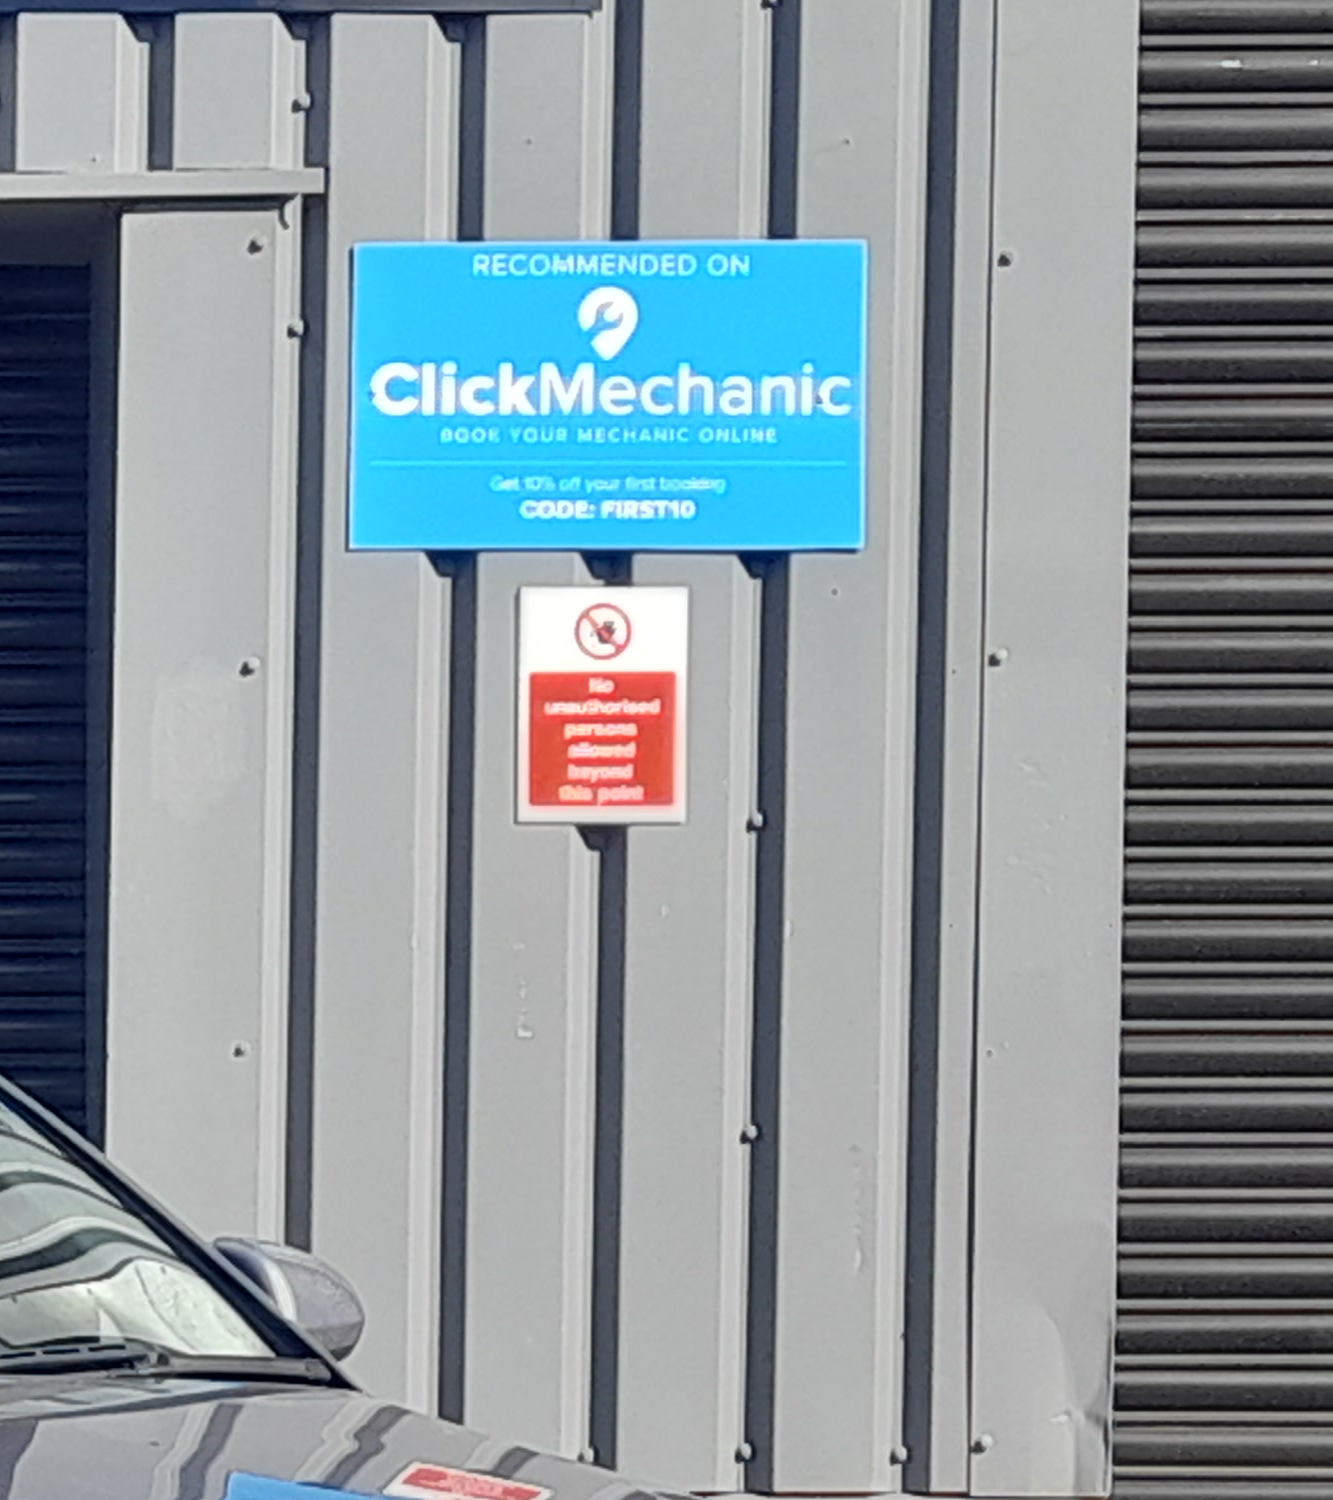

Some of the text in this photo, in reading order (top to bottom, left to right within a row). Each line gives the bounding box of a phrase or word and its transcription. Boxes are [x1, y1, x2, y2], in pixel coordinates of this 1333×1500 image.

[474, 254, 749, 275] RECOMMENDED ON
[370, 361, 851, 416] ClickMechanic
[440, 427, 777, 443] BOOK YOUR MECHANIC ONLINE
[490, 475, 520, 491] Get
[585, 479, 620, 493] your
[625, 477, 655, 491] first
[521, 500, 696, 518] CODE: FIRST10
[589, 678, 614, 693] No
[544, 699, 660, 715] unauthorised
